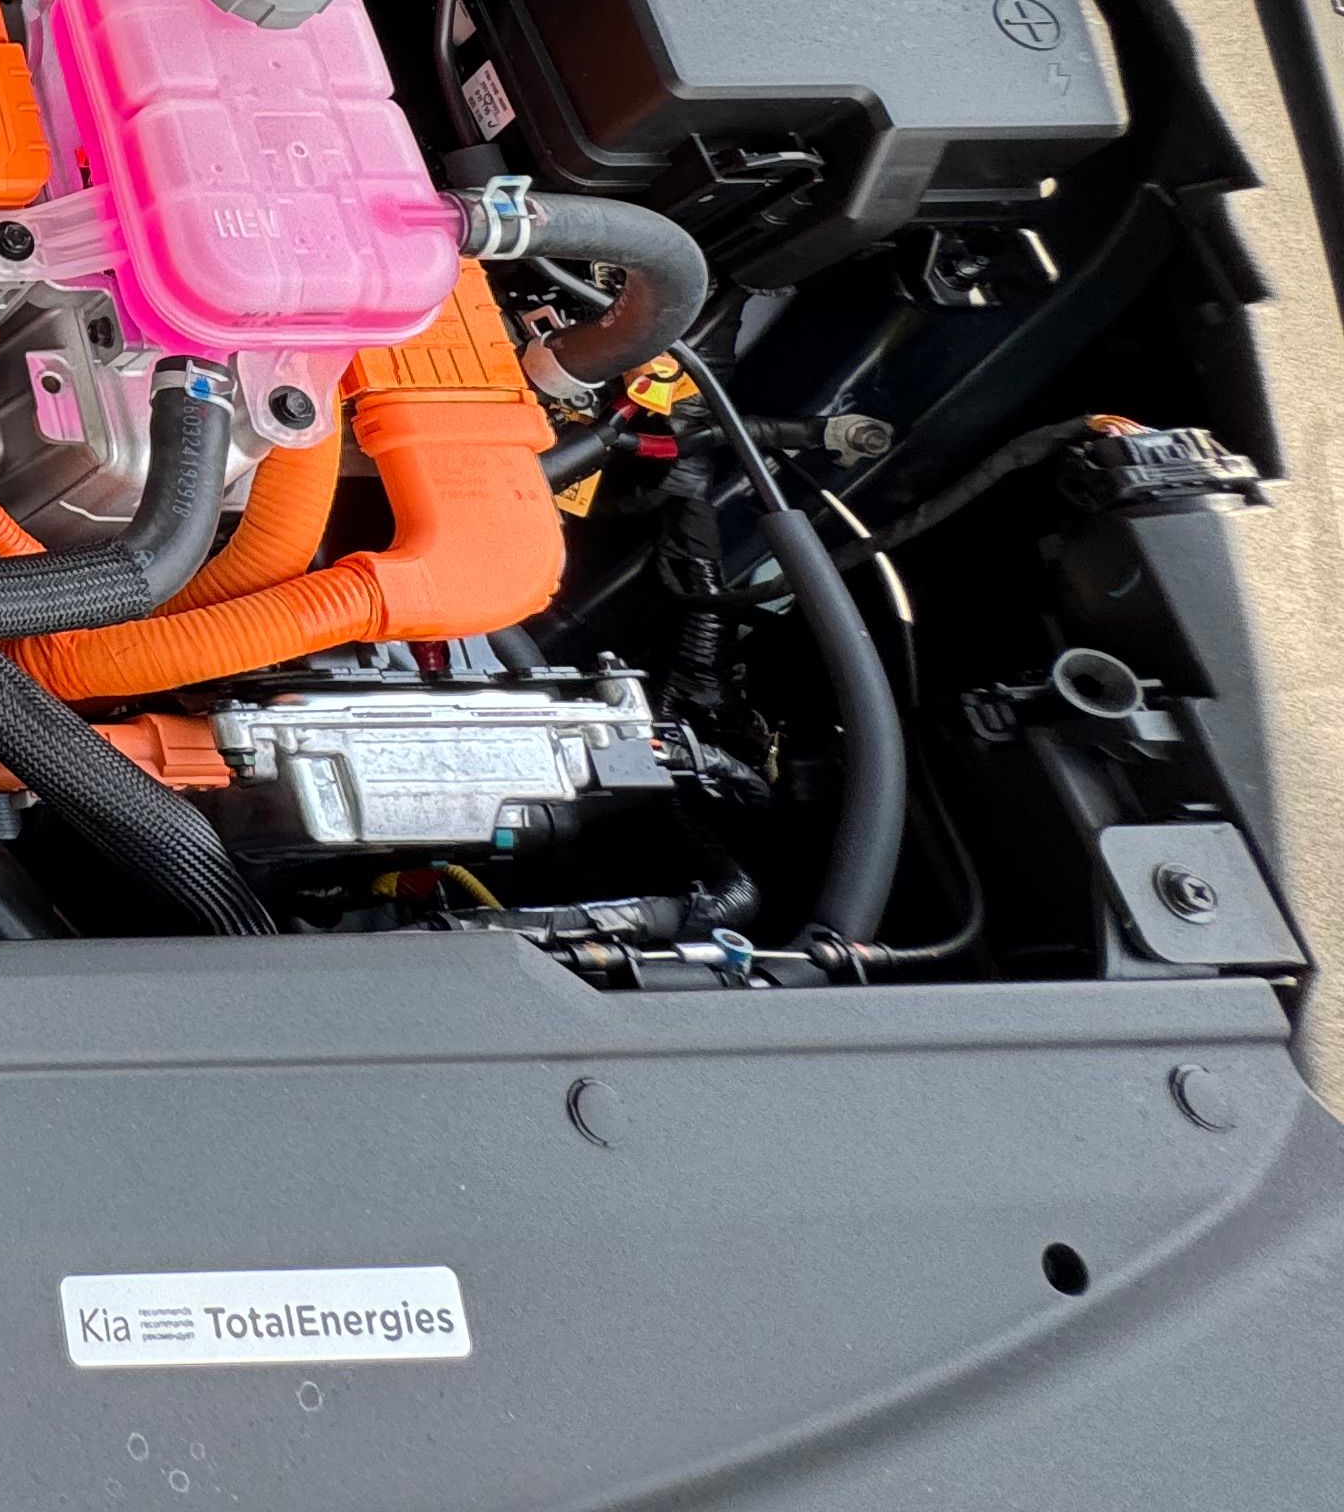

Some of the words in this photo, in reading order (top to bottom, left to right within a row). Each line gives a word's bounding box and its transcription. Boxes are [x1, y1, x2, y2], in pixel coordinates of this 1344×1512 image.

[212, 208, 281, 239] HEV
[78, 1307, 132, 1344] Kia
[203, 1300, 455, 1342] TotalEnergies
